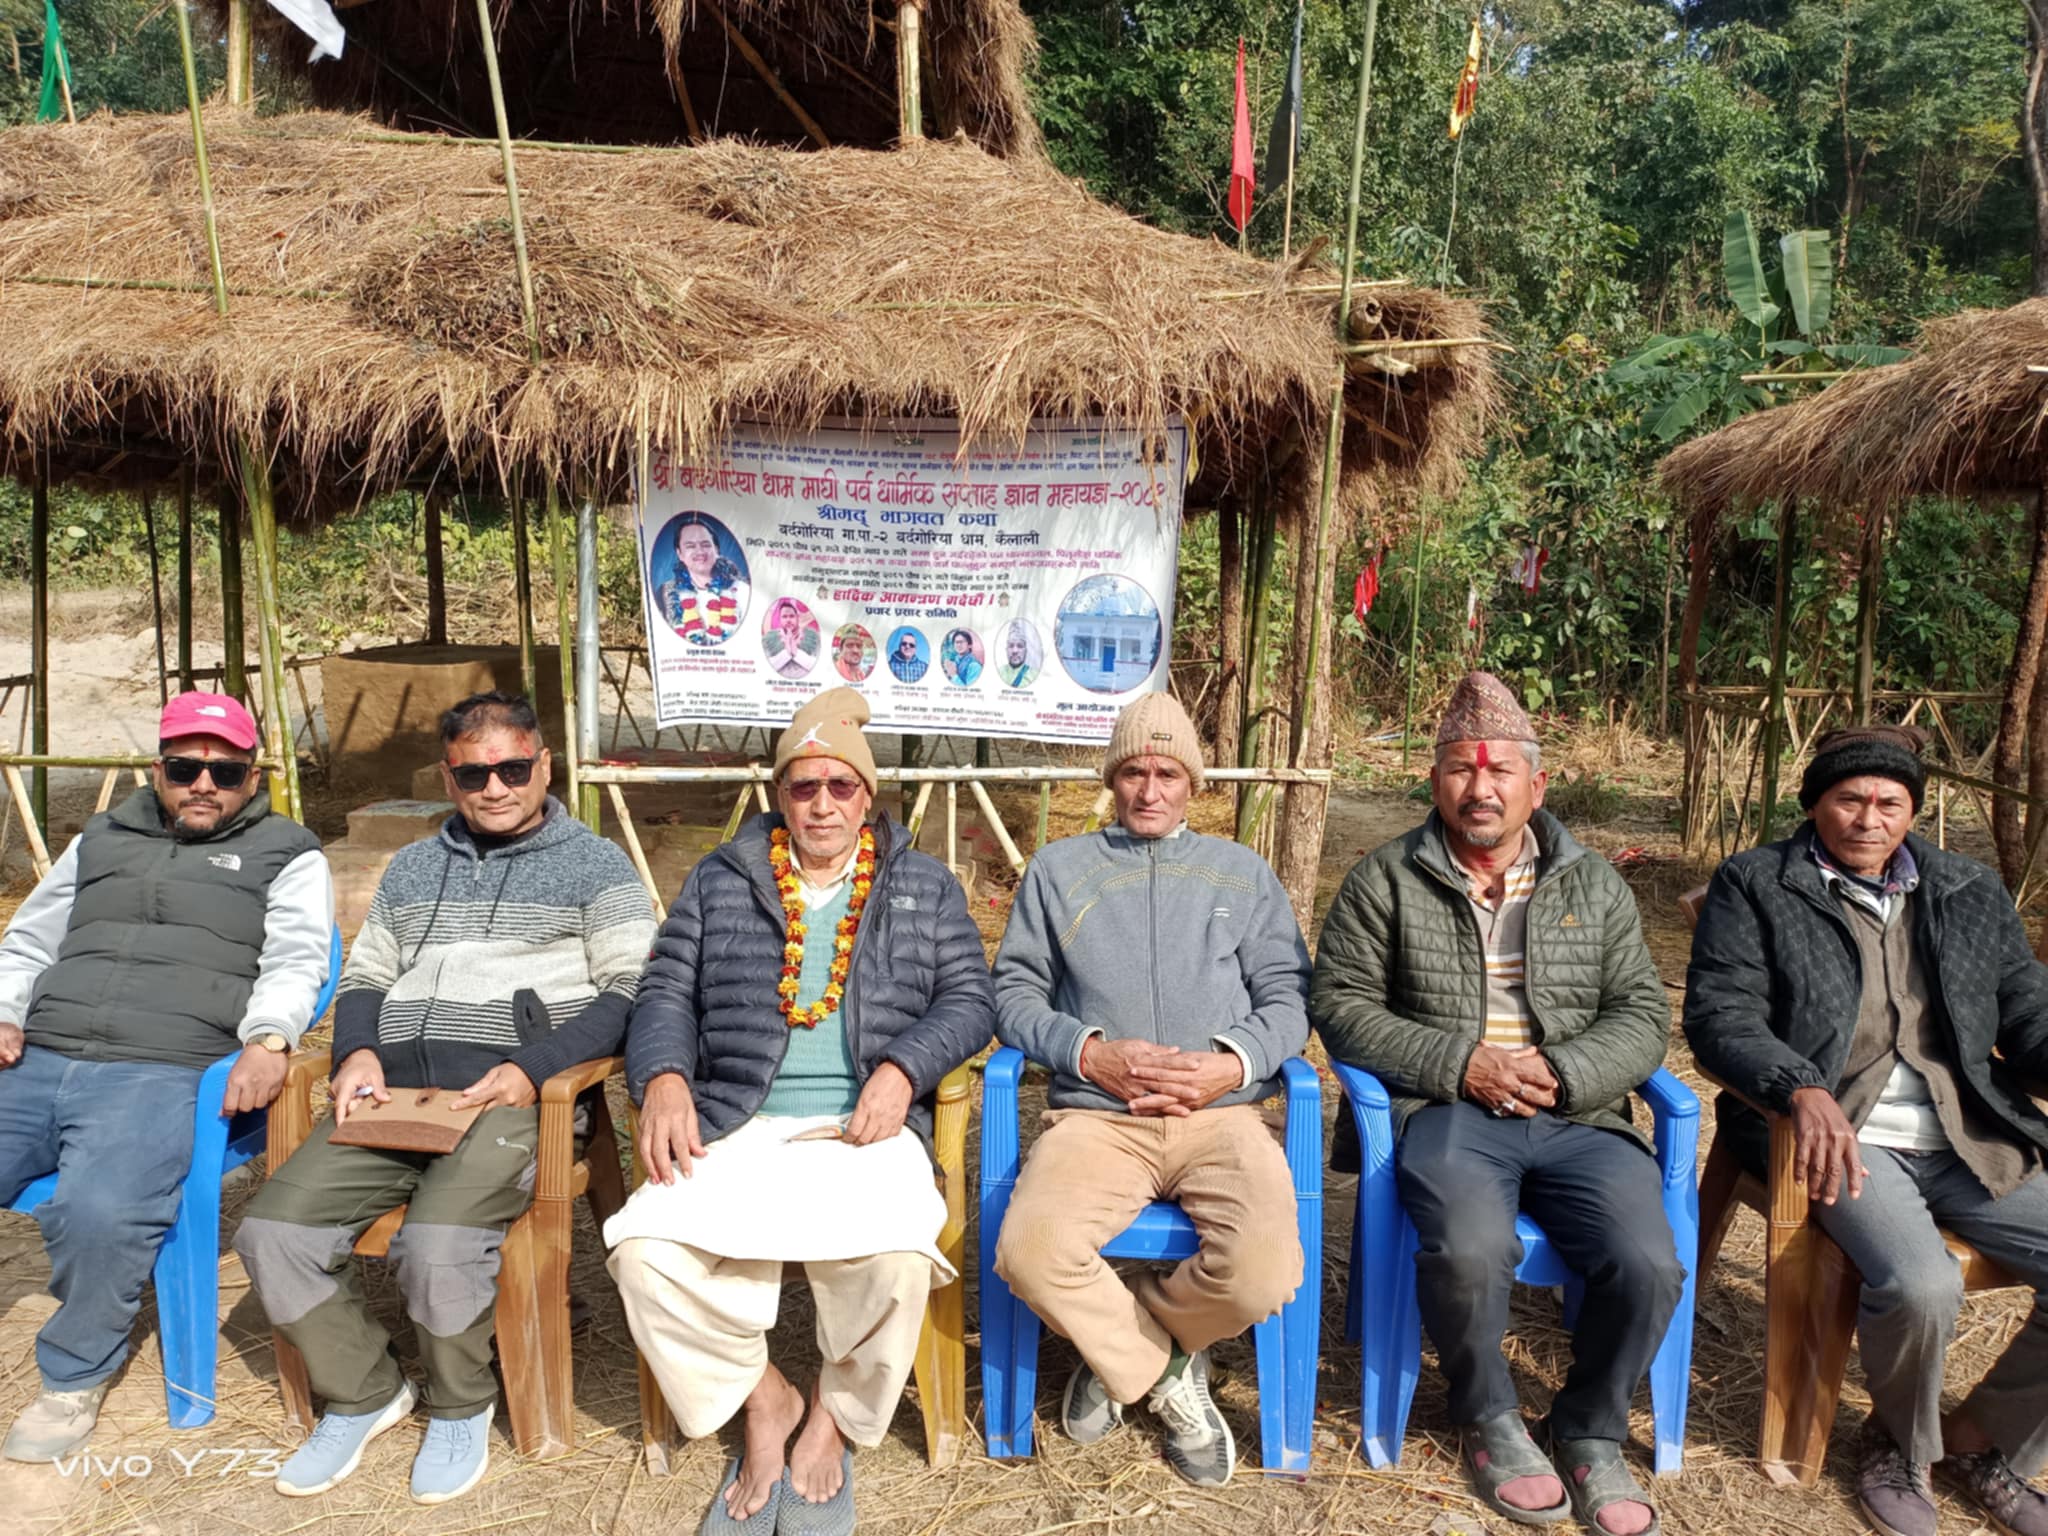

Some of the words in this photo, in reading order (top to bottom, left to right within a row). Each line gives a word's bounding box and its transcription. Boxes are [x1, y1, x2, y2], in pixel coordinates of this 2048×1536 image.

[762, 471, 795, 498] धाम
[800, 467, 839, 502] माघी
[845, 470, 874, 502] पर्व
[877, 471, 936, 507] धार्मिक
[942, 483, 999, 511] सप्ताह
[1004, 484, 1042, 509] ज्ञान
[817, 503, 869, 528] श्रीमद्
[880, 509, 945, 527] भागवत
[957, 512, 999, 527] कथा
